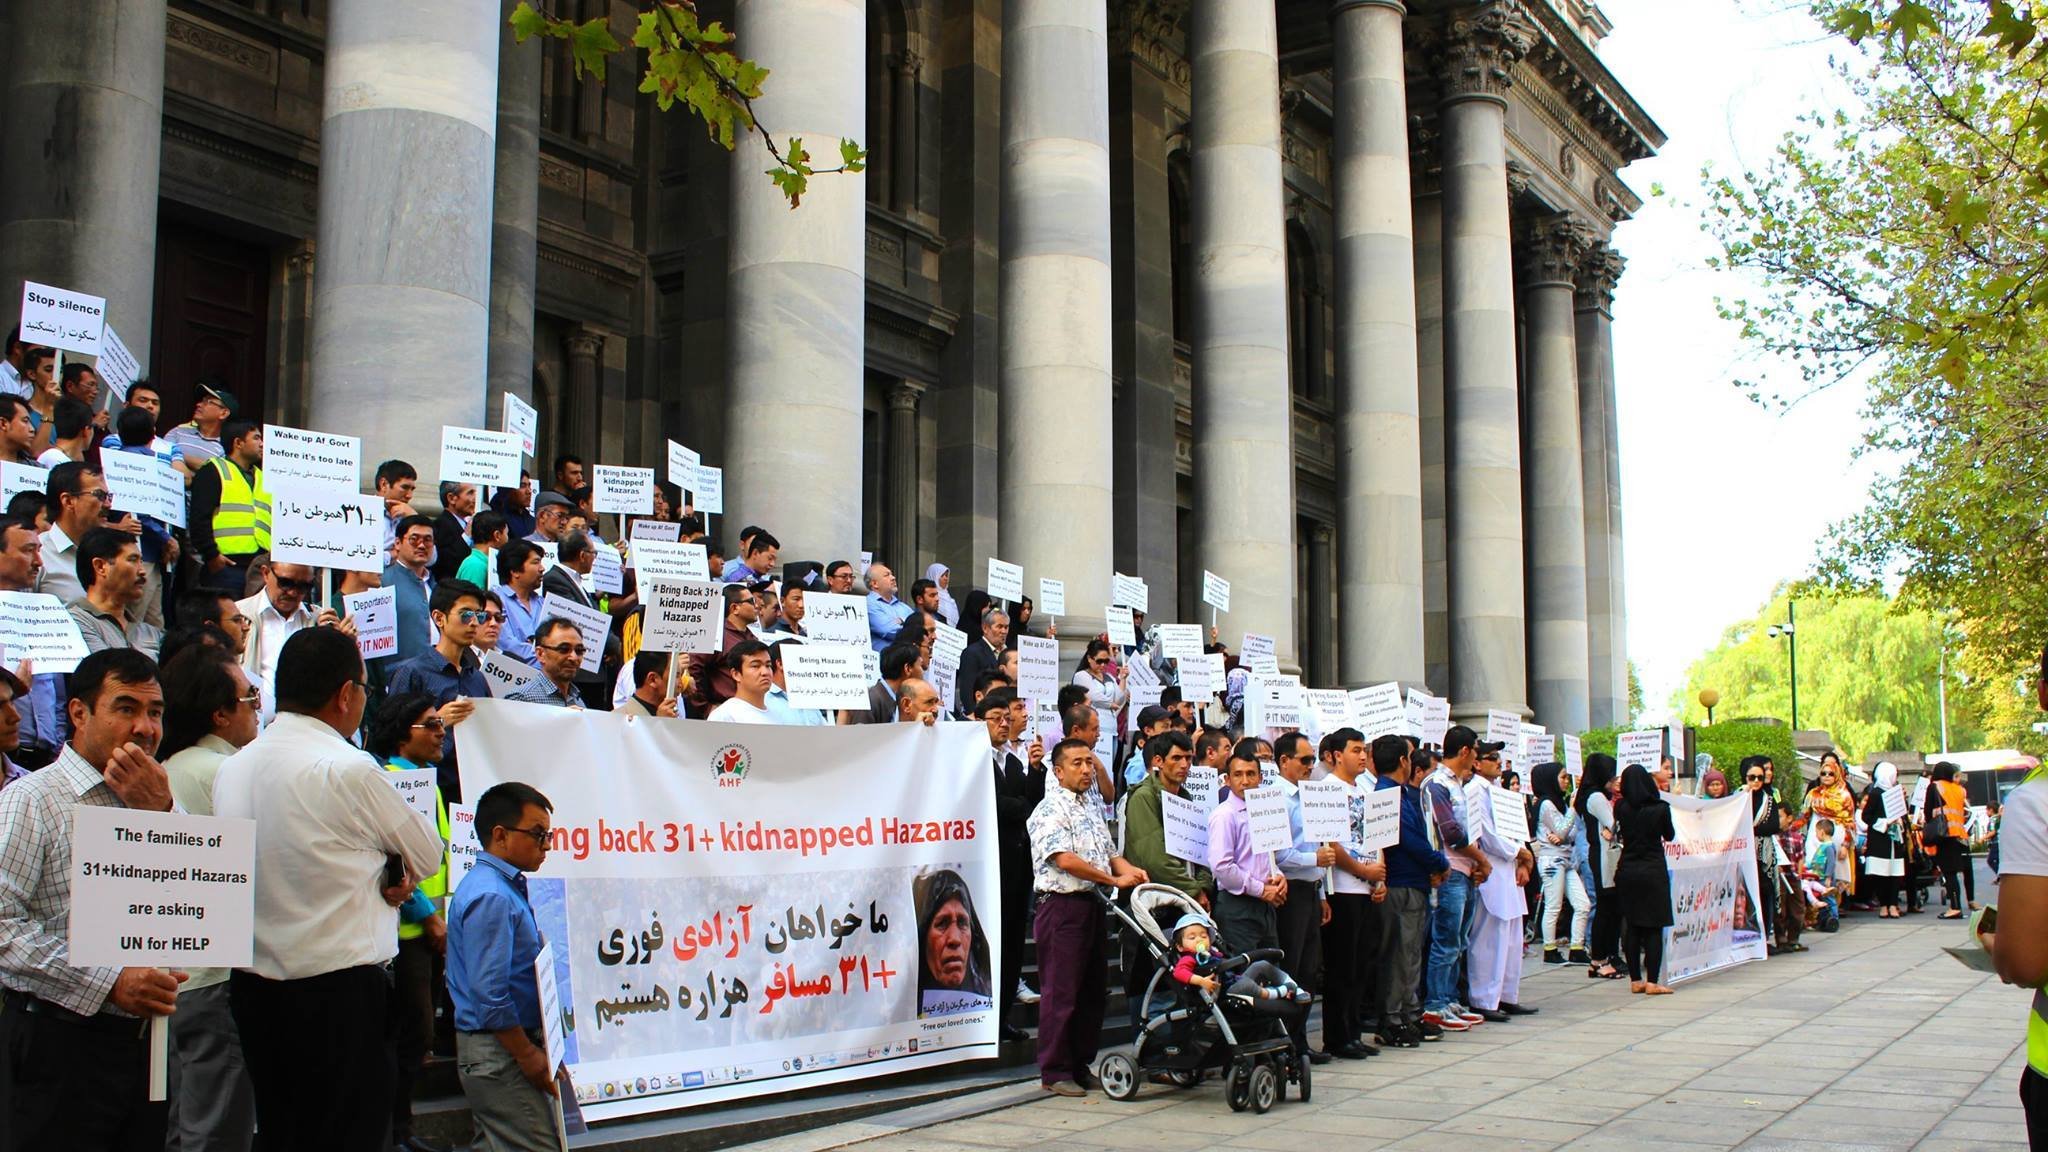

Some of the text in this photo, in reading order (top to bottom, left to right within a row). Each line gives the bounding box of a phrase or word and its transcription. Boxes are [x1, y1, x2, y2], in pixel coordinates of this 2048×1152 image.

[28, 292, 100, 316] Stop silence
[274, 430, 299, 441] Wake
[316, 436, 325, 444] Af
[329, 439, 350, 448] Govt
[270, 448, 353, 467] before it's too late
[603, 469, 620, 478] Bring
[19, 476, 40, 487] Being
[604, 478, 644, 488] kidnapped
[607, 486, 640, 495] Hazaras
[660, 585, 680, 597] Bring
[683, 586, 702, 596] Back
[705, 587, 718, 597] 31+
[353, 595, 392, 612] Deportation
[660, 598, 709, 611] kidnapped
[662, 611, 702, 623] Hazaras
[363, 640, 371, 652] IT
[799, 656, 820, 664] Being
[1409, 697, 1424, 708] Stop
[1187, 771, 1203, 779] Back
[400, 780, 429, 790] Afg Govt
[720, 778, 742, 787] AHF
[456, 812, 474, 822] STOP
[115, 827, 222, 847] The families of
[470, 830, 475, 839] &
[598, 818, 656, 853] back
[719, 817, 873, 856] kidnapped
[881, 817, 976, 844] Hazaras
[452, 844, 464, 854] Our
[83, 862, 247, 883] 31+kidnapped Hazaras
[128, 902, 204, 919] are asking
[598, 900, 889, 966] ما خواهان آزادی فوری
[121, 936, 210, 950] UN for HELP
[759, 962, 831, 1014] مسافر
[678, 970, 749, 1021] هزاره
[595, 982, 671, 1030] هستیم
